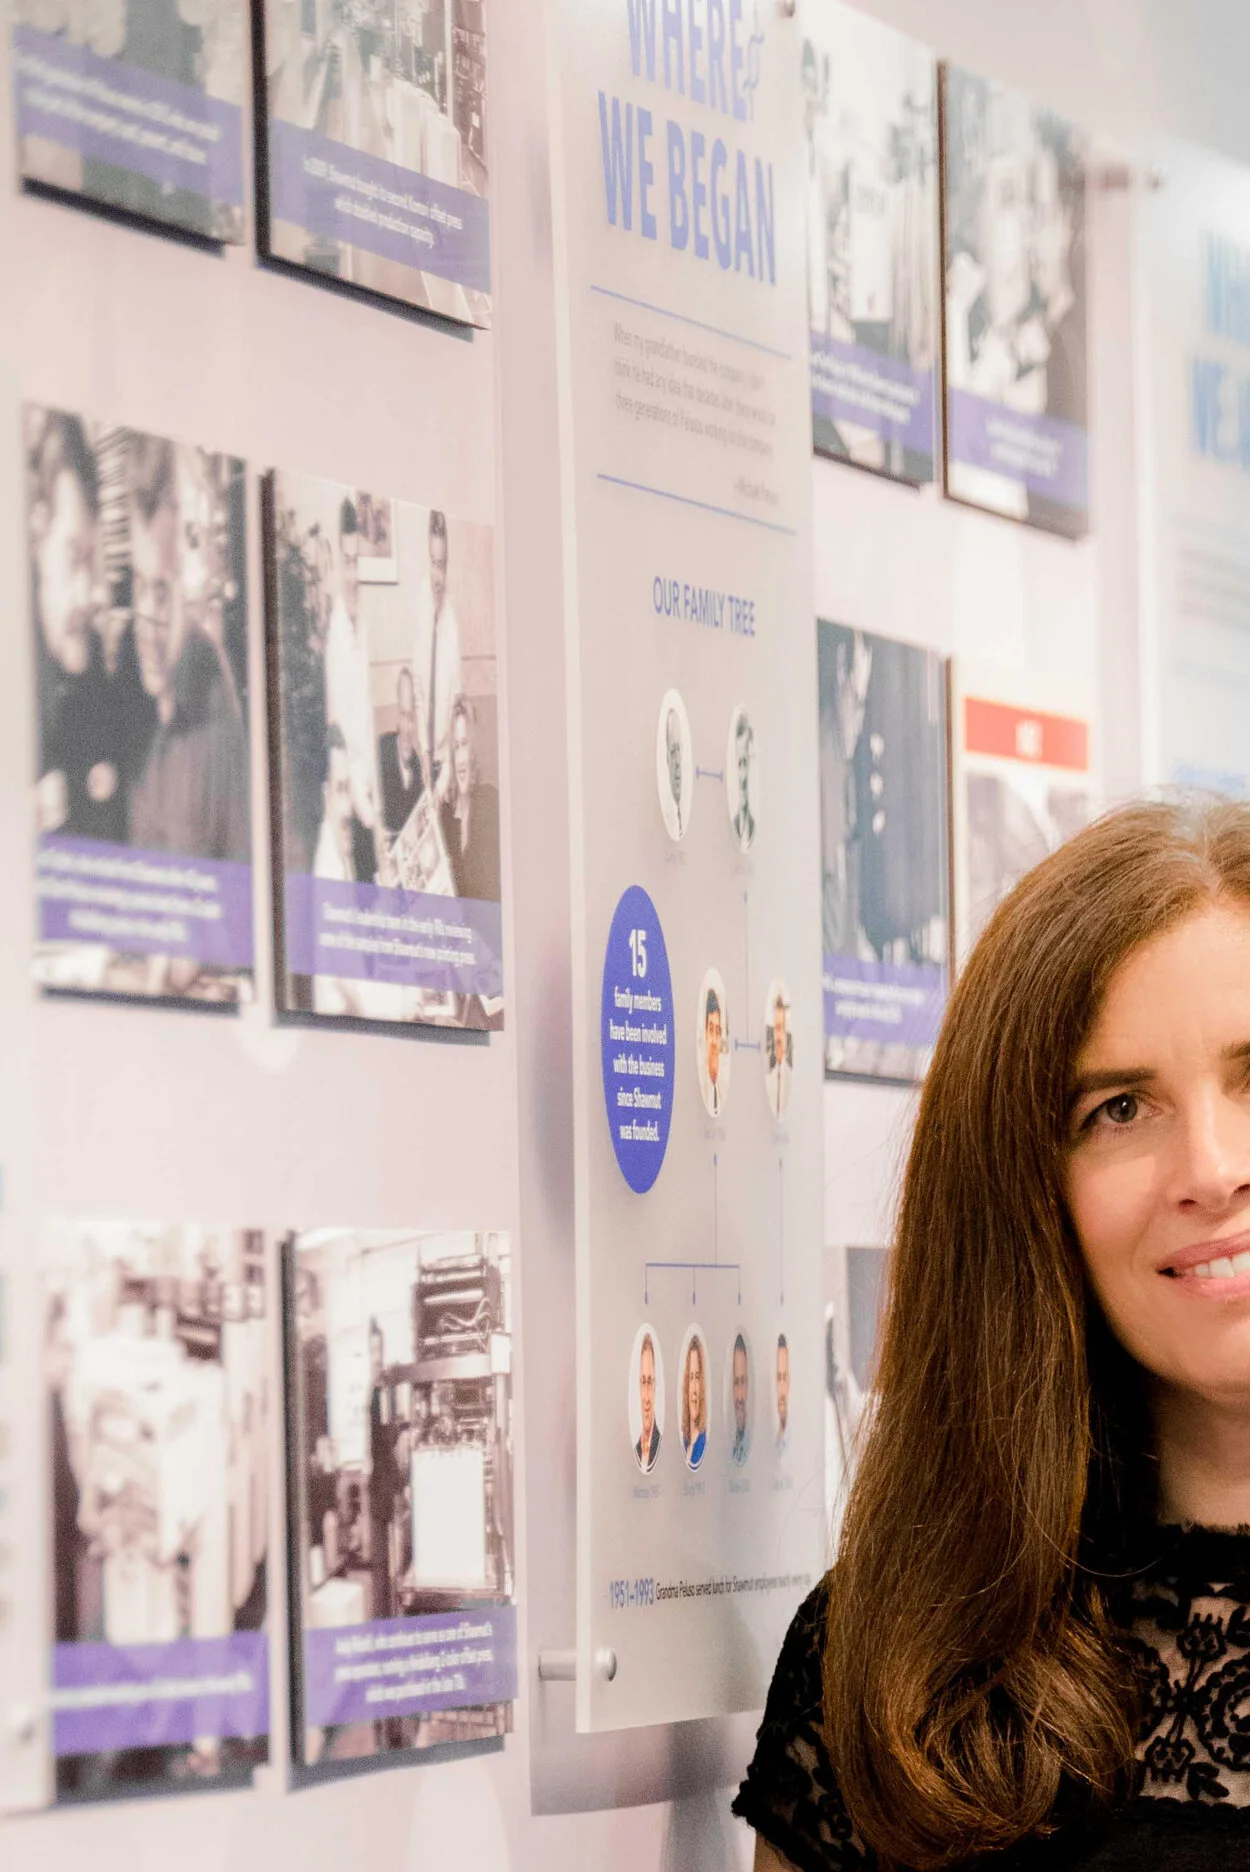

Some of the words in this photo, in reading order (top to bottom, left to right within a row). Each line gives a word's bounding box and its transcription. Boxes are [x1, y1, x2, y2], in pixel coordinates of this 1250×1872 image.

[626, 0, 747, 121] WHERE
[598, 89, 657, 241] WE
[666, 119, 776, 287] BEGAN
[653, 576, 681, 620] OUR
[684, 584, 725, 630] FAMILY
[728, 594, 756, 638] TREE
[629, 928, 647, 978] 15
[614, 985, 633, 1014] family
[634, 989, 662, 1012] members
[609, 1018, 625, 1041] have
[625, 1020, 641, 1042] been
[642, 1022, 667, 1045] involved
[613, 1053, 627, 1073] with
[628, 1053, 639, 1075] the
[639, 1054, 665, 1078] business
[617, 1086, 634, 1108] since
[634, 1087, 662, 1110] Shawmut
[619, 1124, 632, 1140] was
[632, 1118, 660, 1142] founded.
[656, 1581, 679, 1601] Grandma
